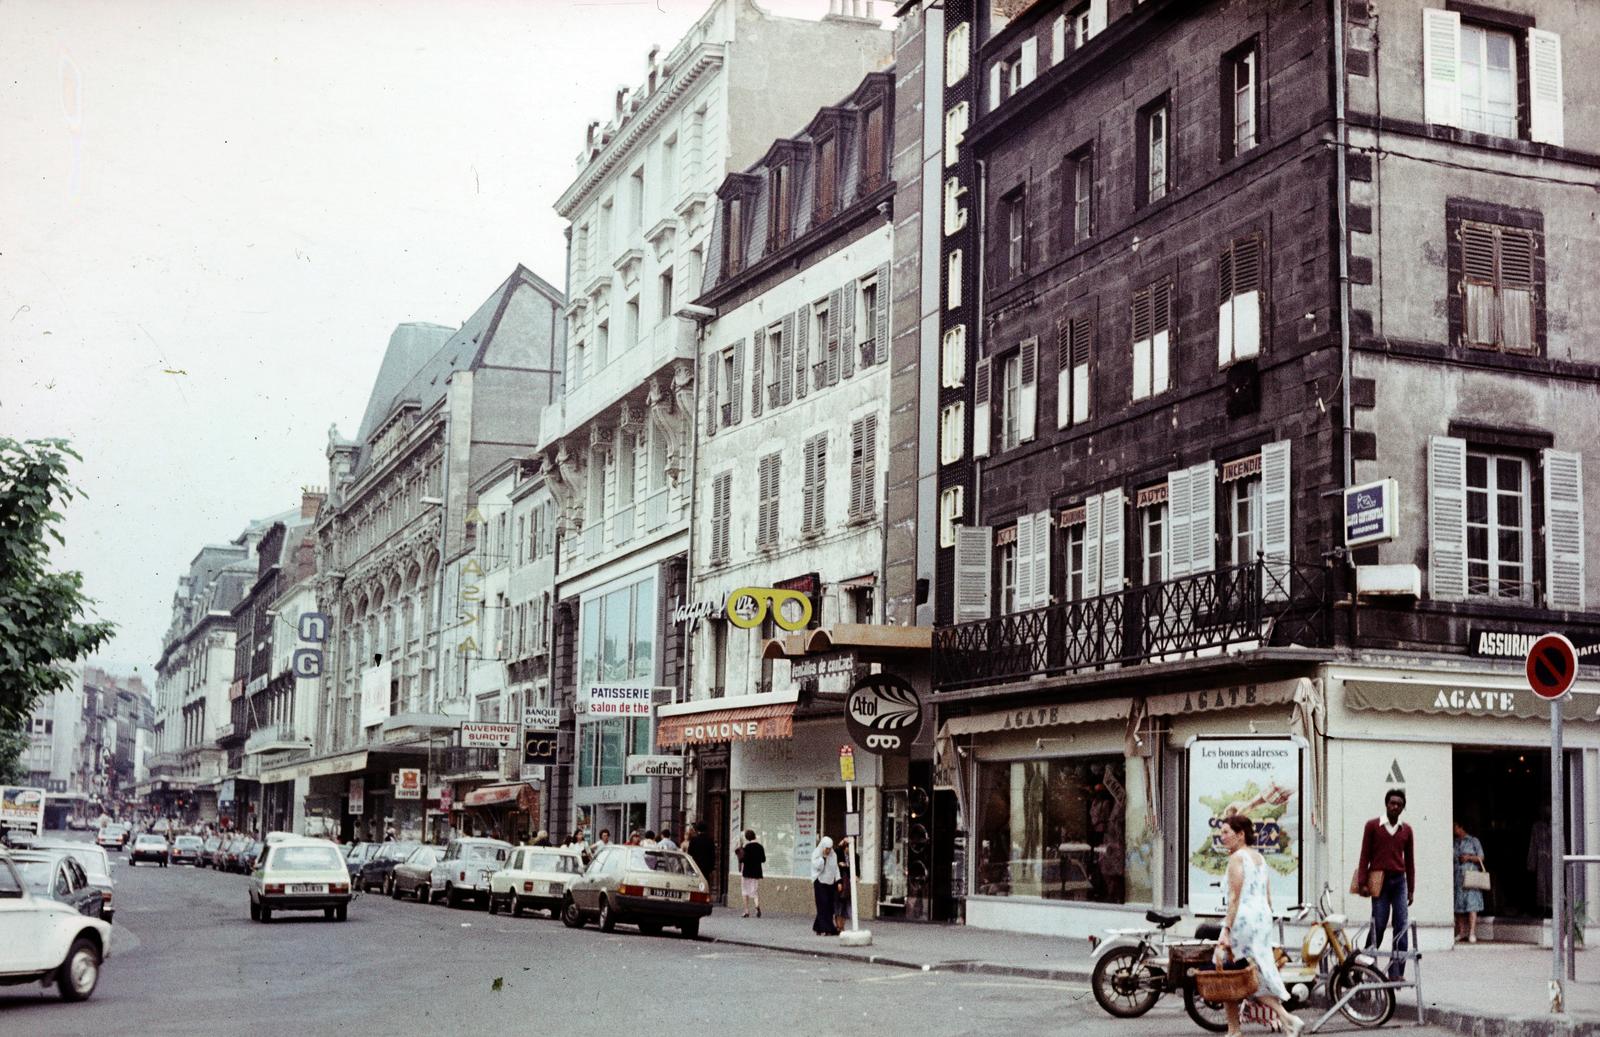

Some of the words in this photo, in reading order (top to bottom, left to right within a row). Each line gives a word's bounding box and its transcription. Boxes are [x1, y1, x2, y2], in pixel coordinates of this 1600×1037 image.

[818, 658, 827, 673] de
[591, 687, 649, 699] PATISSERIE
[1183, 685, 1257, 711] AGATE
[1434, 689, 1514, 711] AGATE
[525, 708, 557, 717] BANQUE
[591, 702, 617, 712] salon
[619, 702, 631, 712] de
[633, 702, 649, 713] the
[852, 696, 878, 716] Atol
[525, 717, 558, 726] CHANGE
[1003, 706, 1058, 728] AGATE
[685, 722, 758, 739] POMONE
[1202, 747, 1216, 757] Les
[1218, 747, 1249, 757] bonnes
[1250, 747, 1288, 757] adresses
[645, 761, 682, 775] coiffure
[1218, 759, 1229, 769] du
